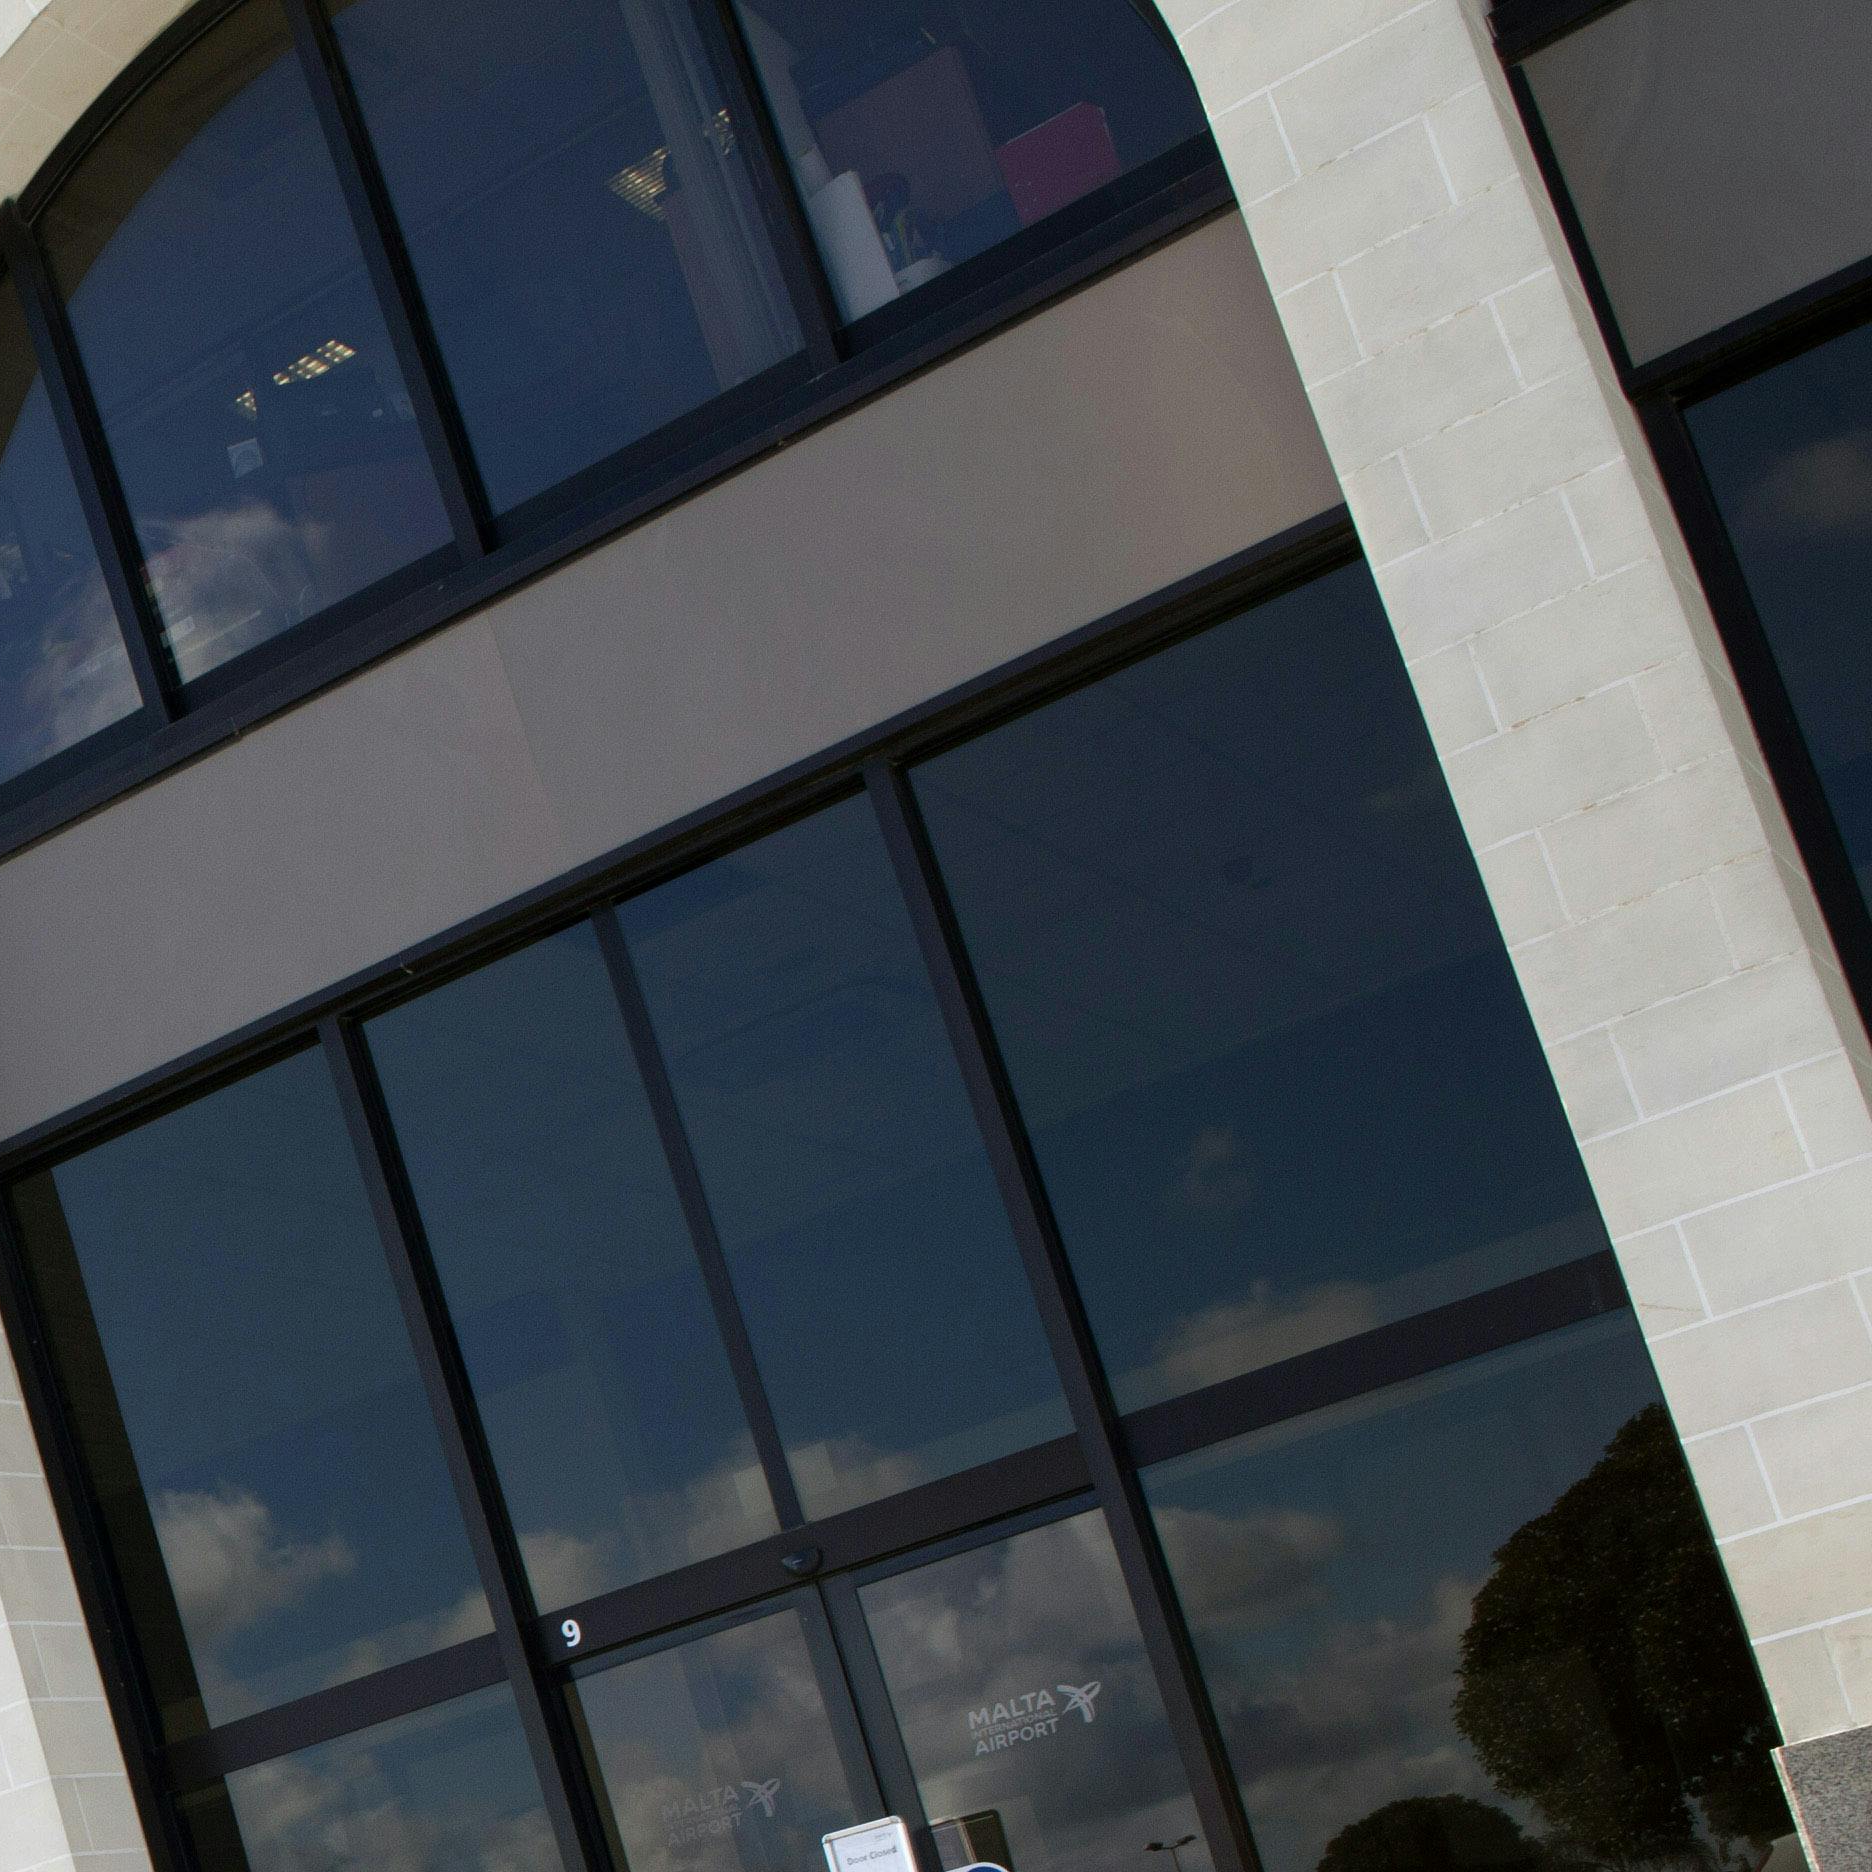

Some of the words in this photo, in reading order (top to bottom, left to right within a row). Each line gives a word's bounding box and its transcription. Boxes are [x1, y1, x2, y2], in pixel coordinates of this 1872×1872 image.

[561, 1619, 581, 1647] 9
[967, 1688, 1057, 1730] MALTA
[975, 1717, 1059, 1757] AIRPORT
[661, 1784, 741, 1824] MALTA
[667, 1810, 745, 1849] AIRPORT
[847, 1853, 868, 1866] Door
[869, 1845, 898, 1860] Closed
